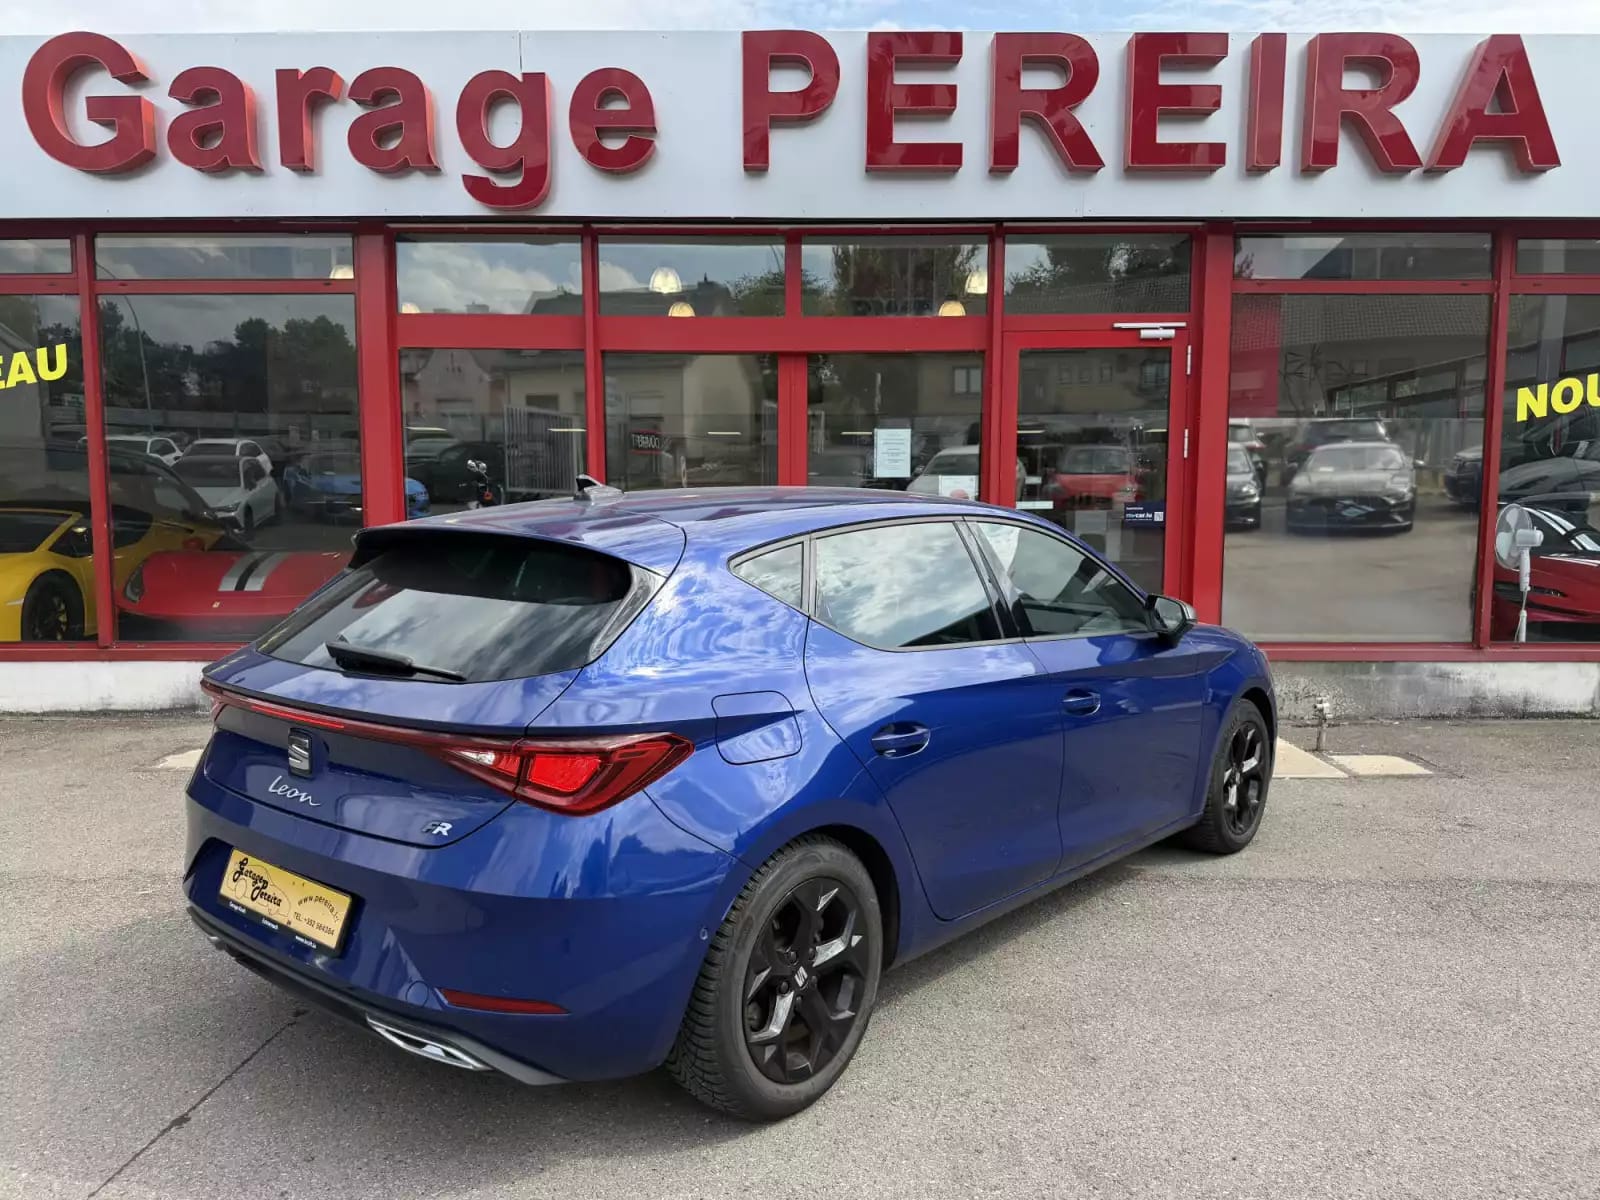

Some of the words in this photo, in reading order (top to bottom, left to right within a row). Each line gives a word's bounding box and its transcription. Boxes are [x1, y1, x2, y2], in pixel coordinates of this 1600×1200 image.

[22, 31, 657, 211] Garage
[742, 30, 1561, 173] PEREIRA
[0, 343, 67, 389] AU
[268, 775, 321, 806] Leon
[232, 857, 264, 888] Garage
[251, 879, 282, 907] Pereira
